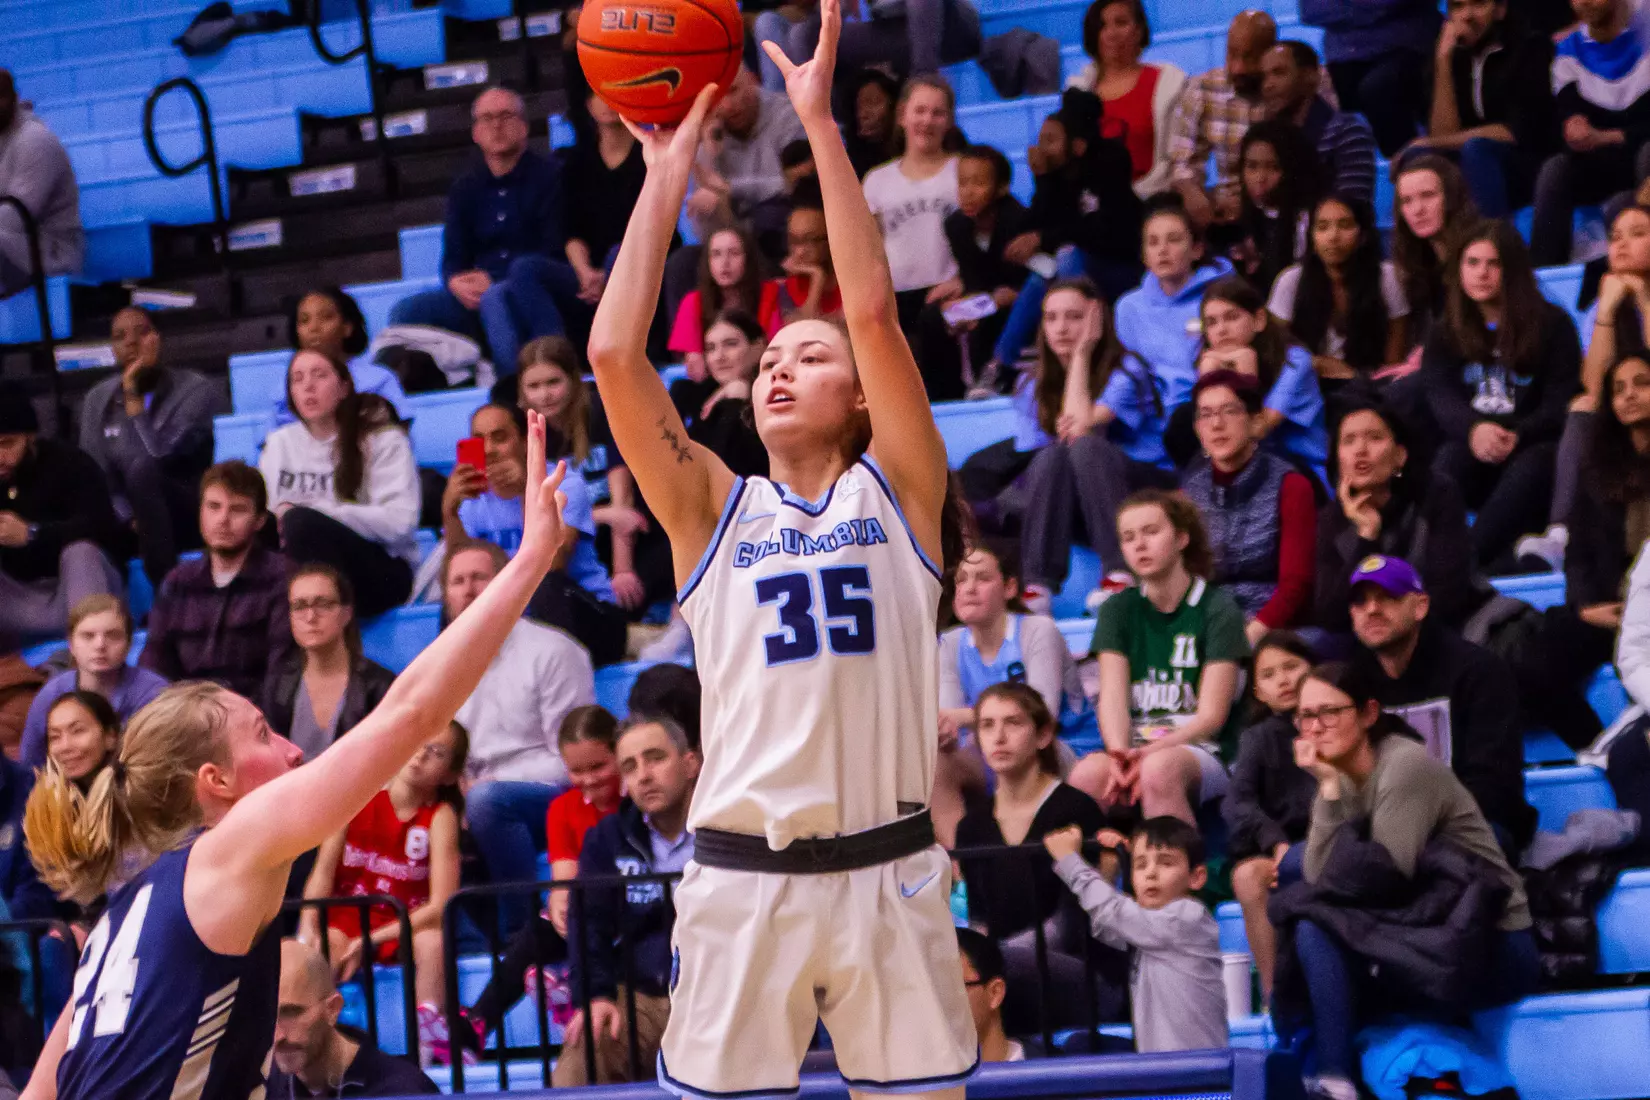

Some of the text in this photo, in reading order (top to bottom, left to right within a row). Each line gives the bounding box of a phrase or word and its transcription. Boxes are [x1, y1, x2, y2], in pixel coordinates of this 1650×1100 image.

[601, 9, 677, 34] ELITE
[733, 517, 888, 568] COLUMBIA
[753, 563, 876, 668] 35
[1169, 634, 1199, 668] 11
[405, 826, 429, 861] 8
[66, 884, 154, 1051] 24
